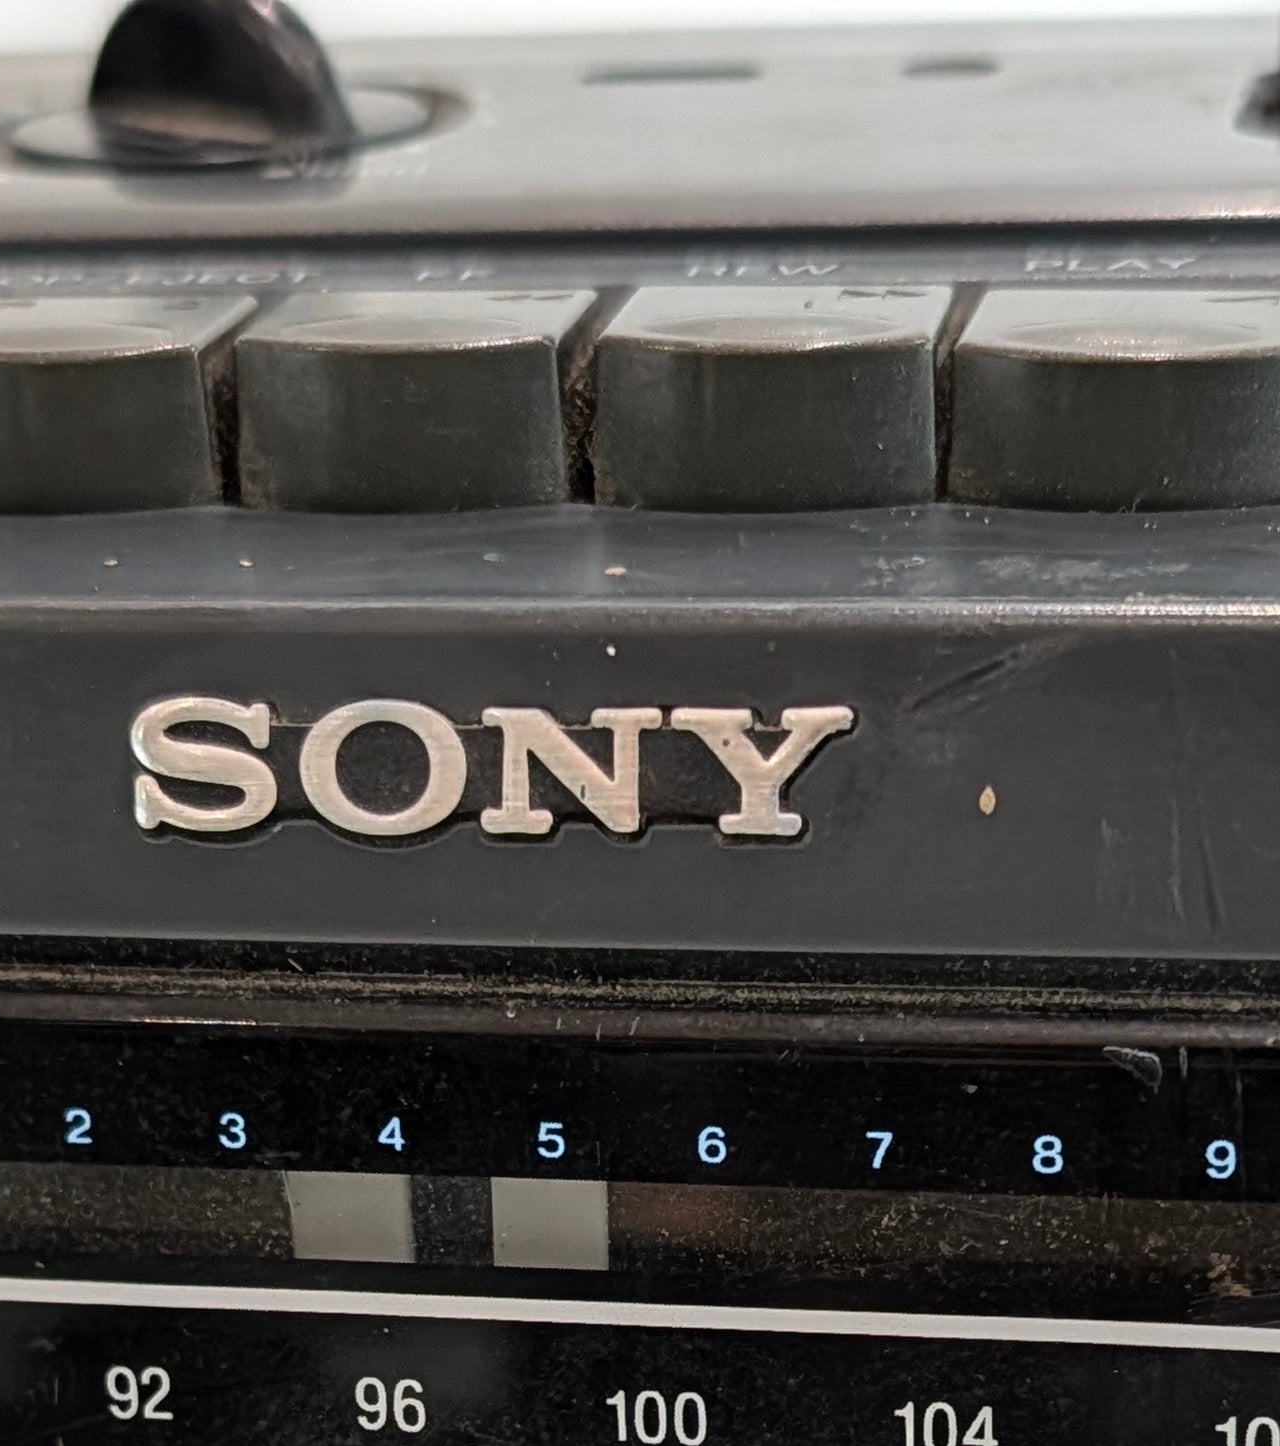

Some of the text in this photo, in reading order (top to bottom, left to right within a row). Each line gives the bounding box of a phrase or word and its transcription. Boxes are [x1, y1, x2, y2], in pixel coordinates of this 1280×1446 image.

[131, 696, 854, 838] SONY
[63, 1106, 95, 1146] 2
[216, 1110, 249, 1151] 3
[375, 1114, 408, 1154] 4
[535, 1119, 567, 1161] 5
[695, 1123, 729, 1166] 6
[863, 1129, 895, 1171] 7
[1030, 1132, 1066, 1176] 8
[1202, 1137, 1239, 1181] 9
[104, 1363, 175, 1423] 92
[352, 1374, 428, 1435] 96
